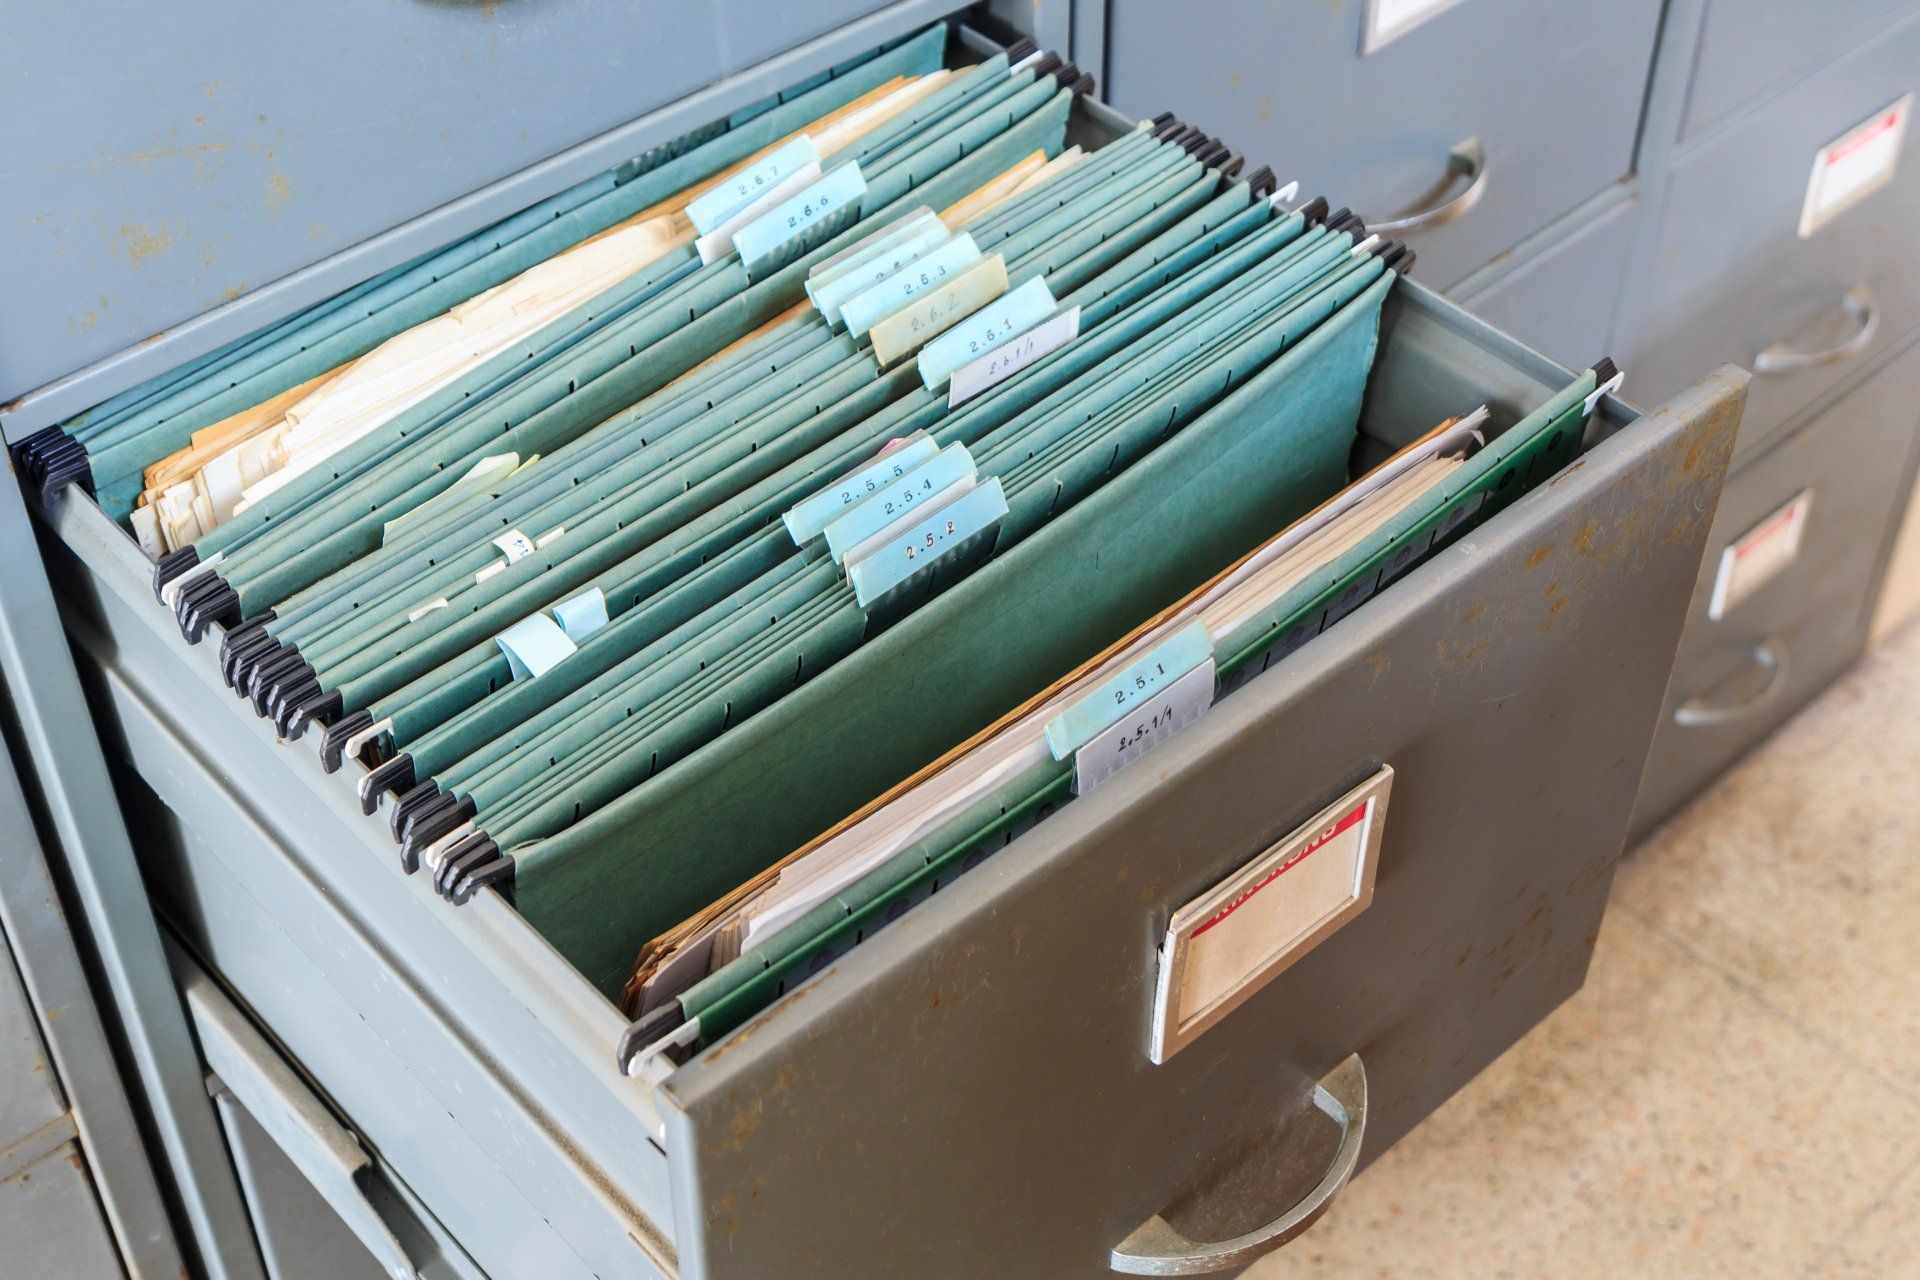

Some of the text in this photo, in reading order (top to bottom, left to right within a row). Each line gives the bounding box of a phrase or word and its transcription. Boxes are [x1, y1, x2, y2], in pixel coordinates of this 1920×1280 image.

[787, 195, 829, 228] 2.6.6
[904, 265, 946, 295] 2.6.3
[969, 318, 1012, 353] 2.6.1
[841, 465, 903, 504] 2.5.5
[884, 478, 933, 515] 2.5.4
[906, 521, 955, 560] 2.5.2
[1115, 662, 1166, 704] 2.5.1
[1118, 704, 1173, 752] 2.5.1/1
